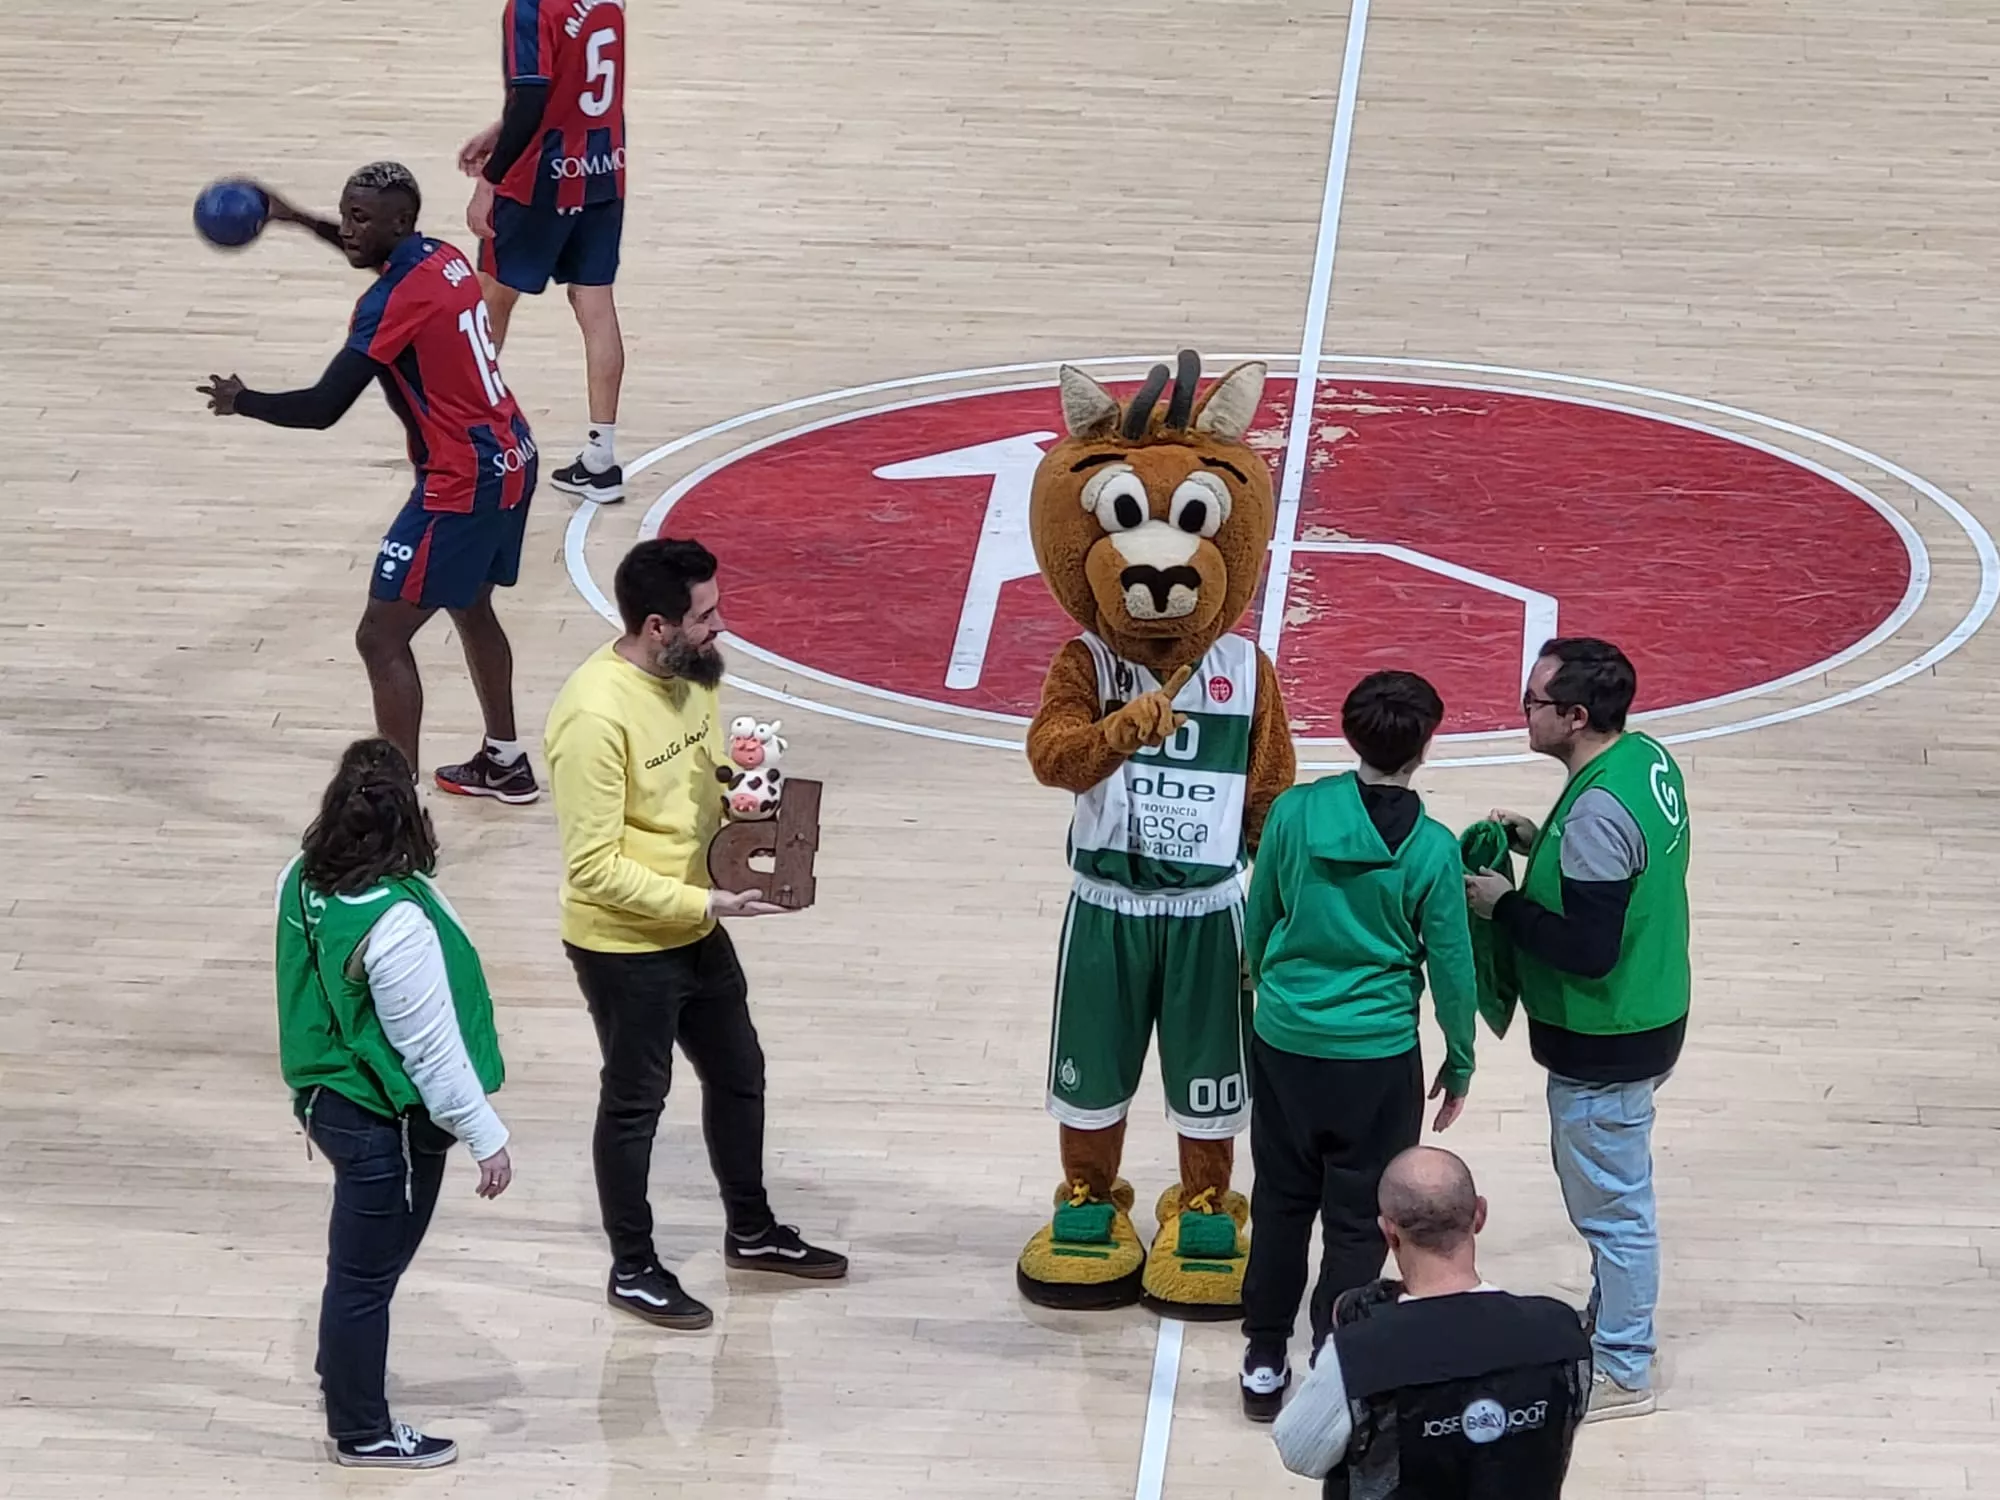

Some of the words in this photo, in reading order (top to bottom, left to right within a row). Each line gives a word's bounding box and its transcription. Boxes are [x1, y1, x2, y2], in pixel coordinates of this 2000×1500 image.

[579, 28, 617, 117] 5
[1189, 1073, 1243, 1113] 00
[1422, 1416, 1461, 1438] JOSE
